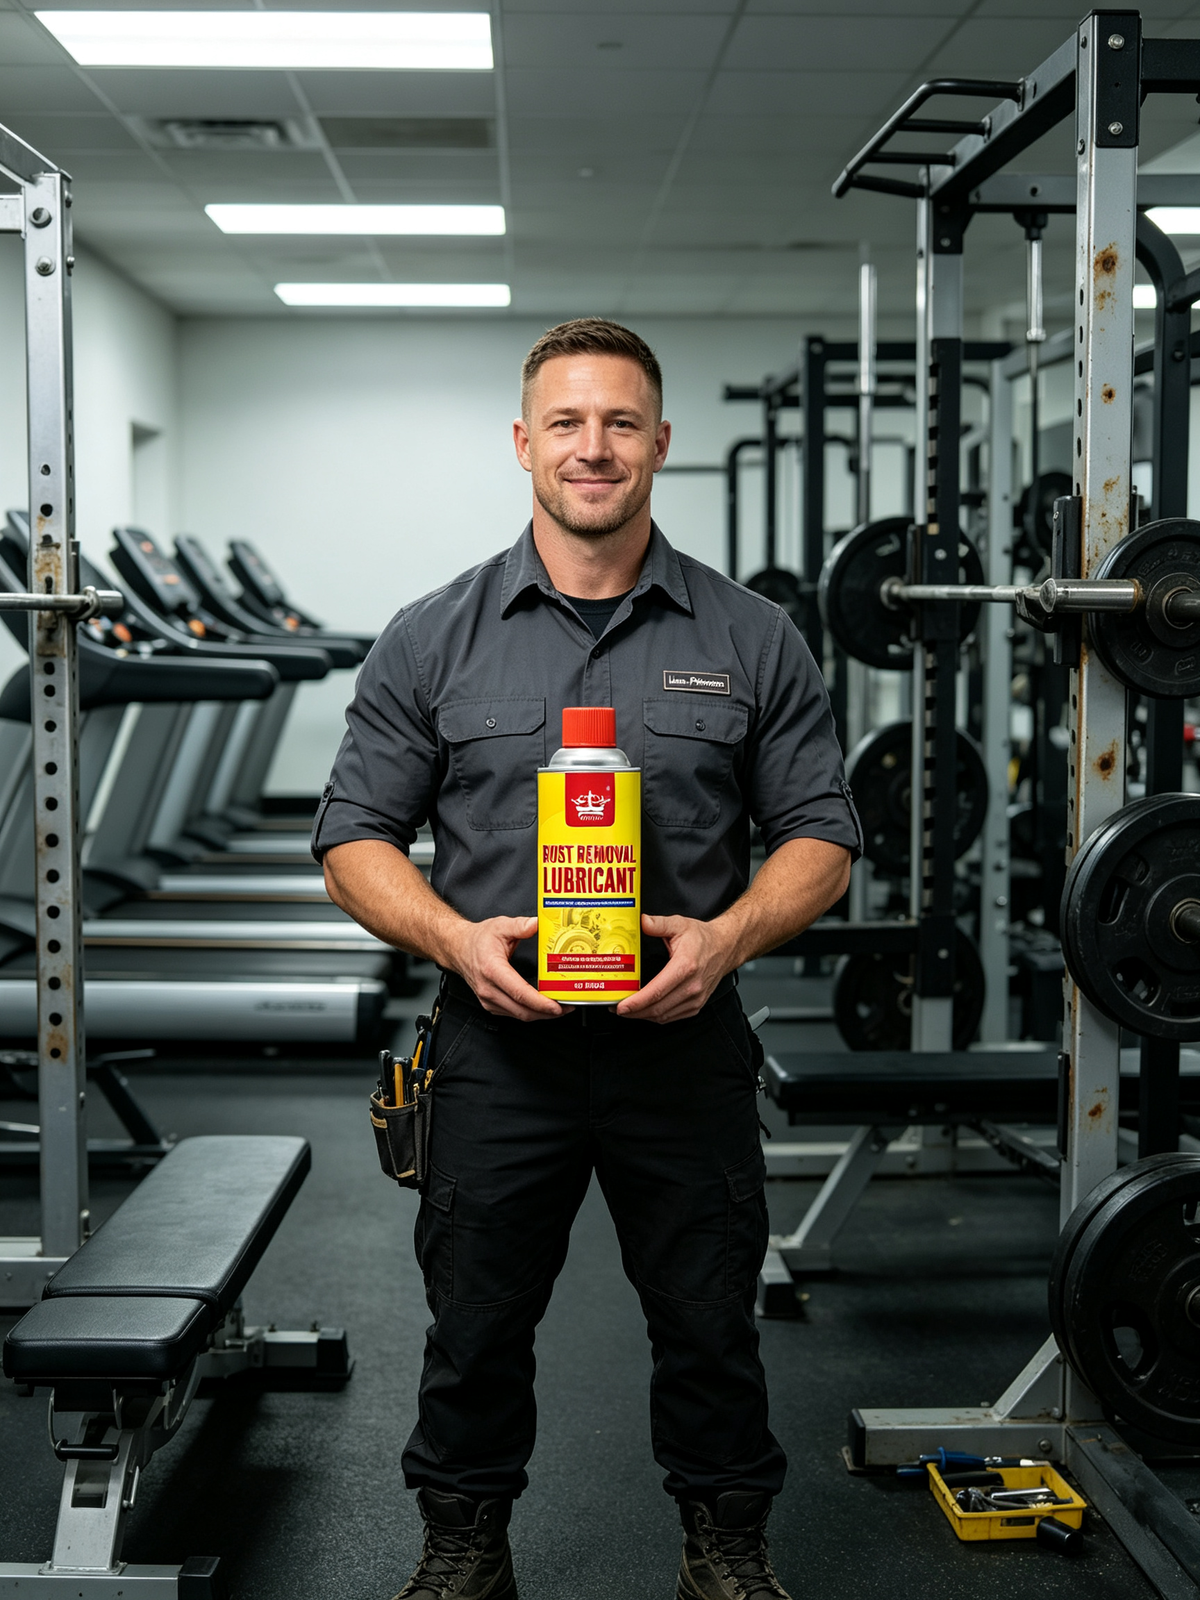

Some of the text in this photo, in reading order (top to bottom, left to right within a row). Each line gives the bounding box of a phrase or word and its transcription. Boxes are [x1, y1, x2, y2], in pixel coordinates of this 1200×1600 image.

[543, 845, 636, 864] RUST REMOVAL
[543, 866, 636, 893] LUBRICANT
